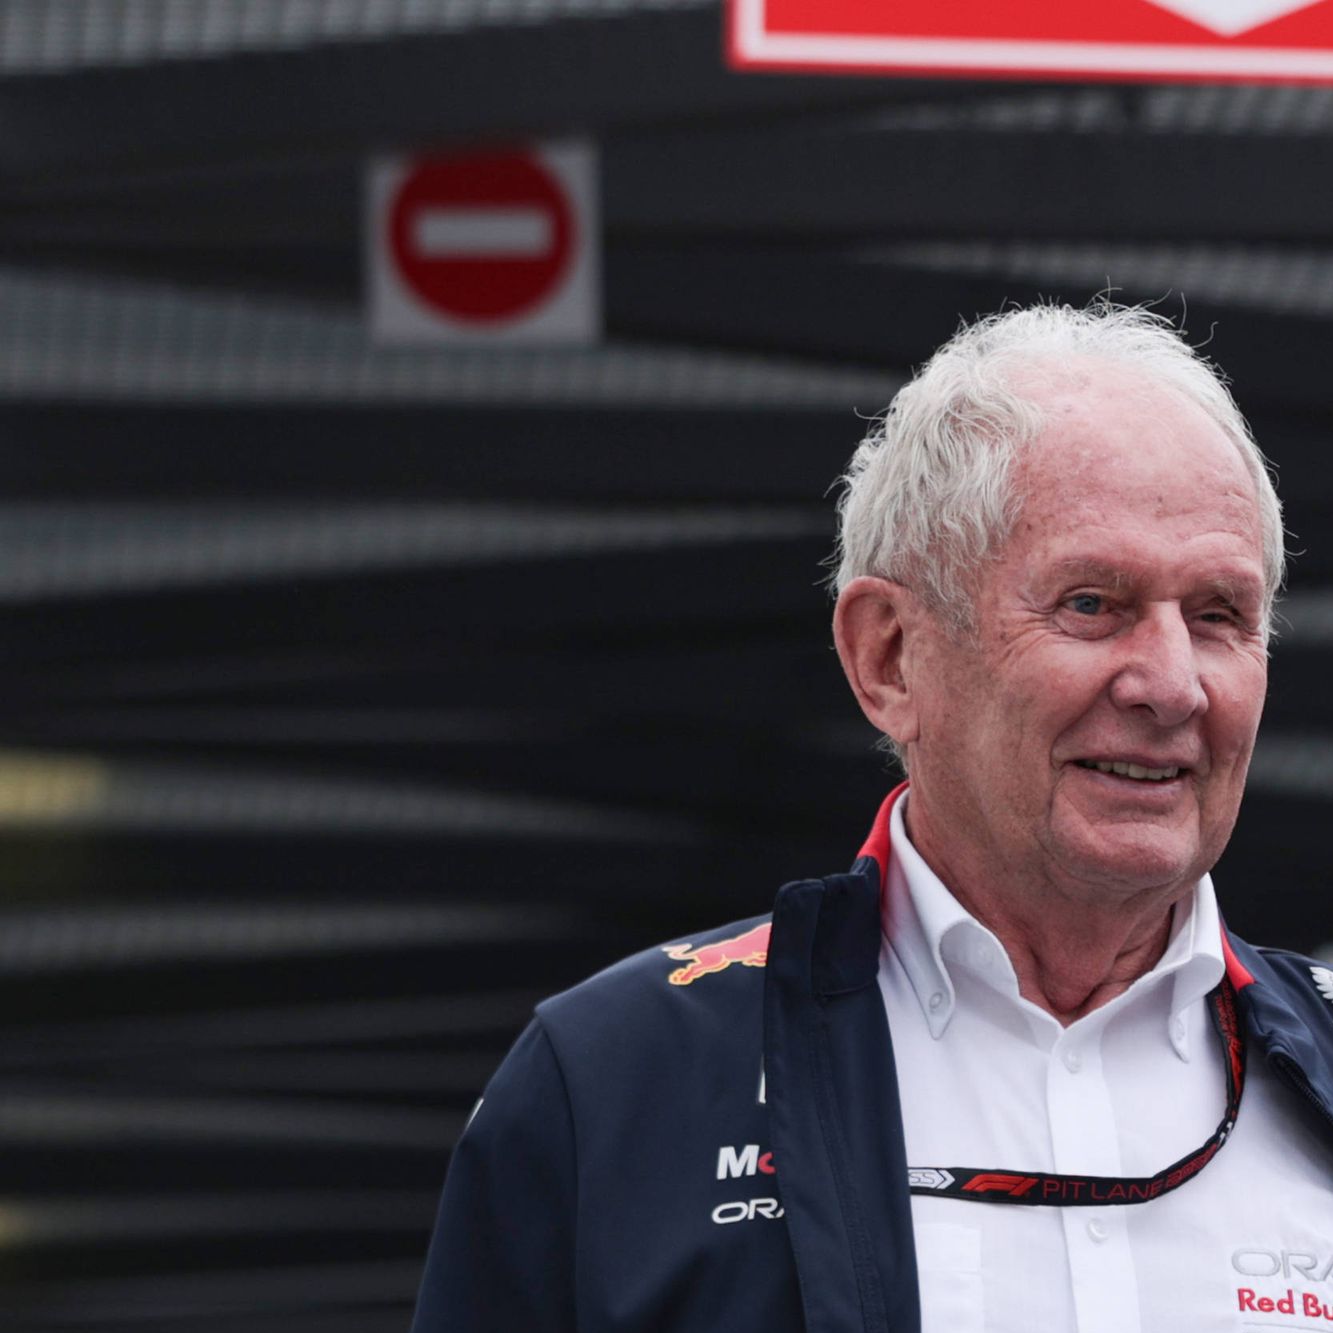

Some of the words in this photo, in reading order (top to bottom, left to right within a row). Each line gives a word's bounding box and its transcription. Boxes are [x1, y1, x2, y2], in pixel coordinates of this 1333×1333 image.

[1042, 1181, 1091, 1200] PIT
[1091, 1178, 1161, 1201] LANE
[1237, 1287, 1295, 1316] Red
